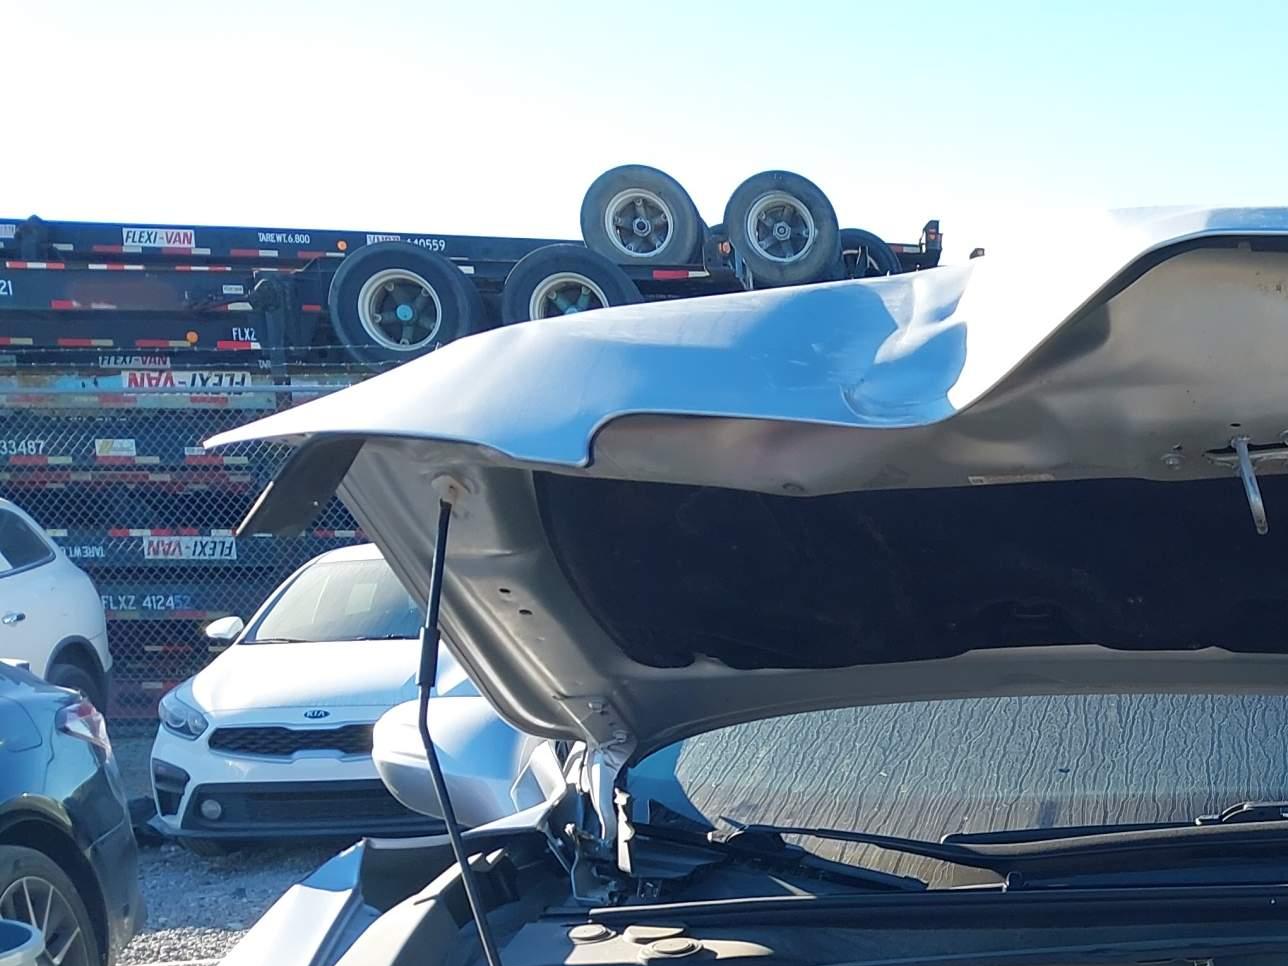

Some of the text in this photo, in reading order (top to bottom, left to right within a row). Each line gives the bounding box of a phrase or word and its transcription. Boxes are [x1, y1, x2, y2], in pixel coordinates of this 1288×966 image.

[125, 230, 194, 246] FLEXI-VAN
[146, 539, 234, 558] FLEXI-VAN
[101, 594, 137, 611] FLXZ
